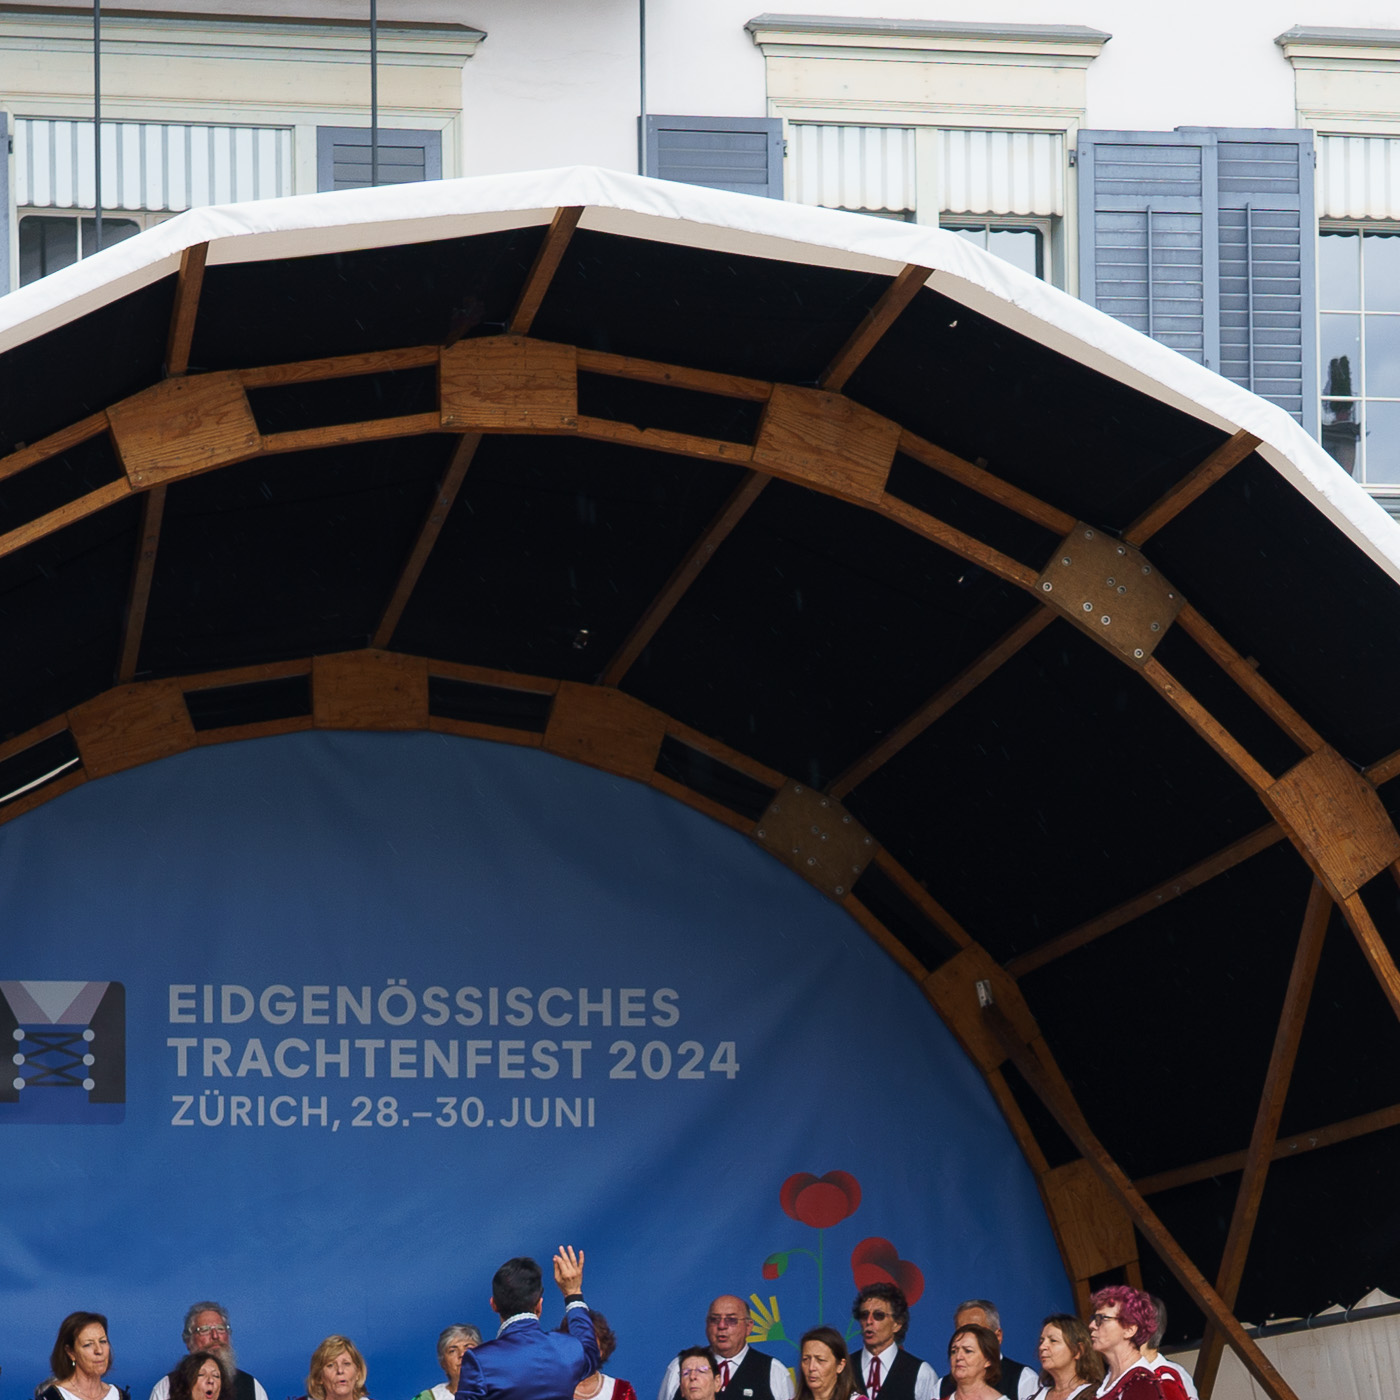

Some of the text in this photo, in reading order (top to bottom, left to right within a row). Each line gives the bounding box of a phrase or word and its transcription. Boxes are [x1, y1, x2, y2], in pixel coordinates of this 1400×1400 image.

[169, 978, 680, 1026] EIDGENÖSSISCHES
[167, 1038, 740, 1080] TRACHTENFEST 2024
[171, 1090, 341, 1132] ZÜRICH,
